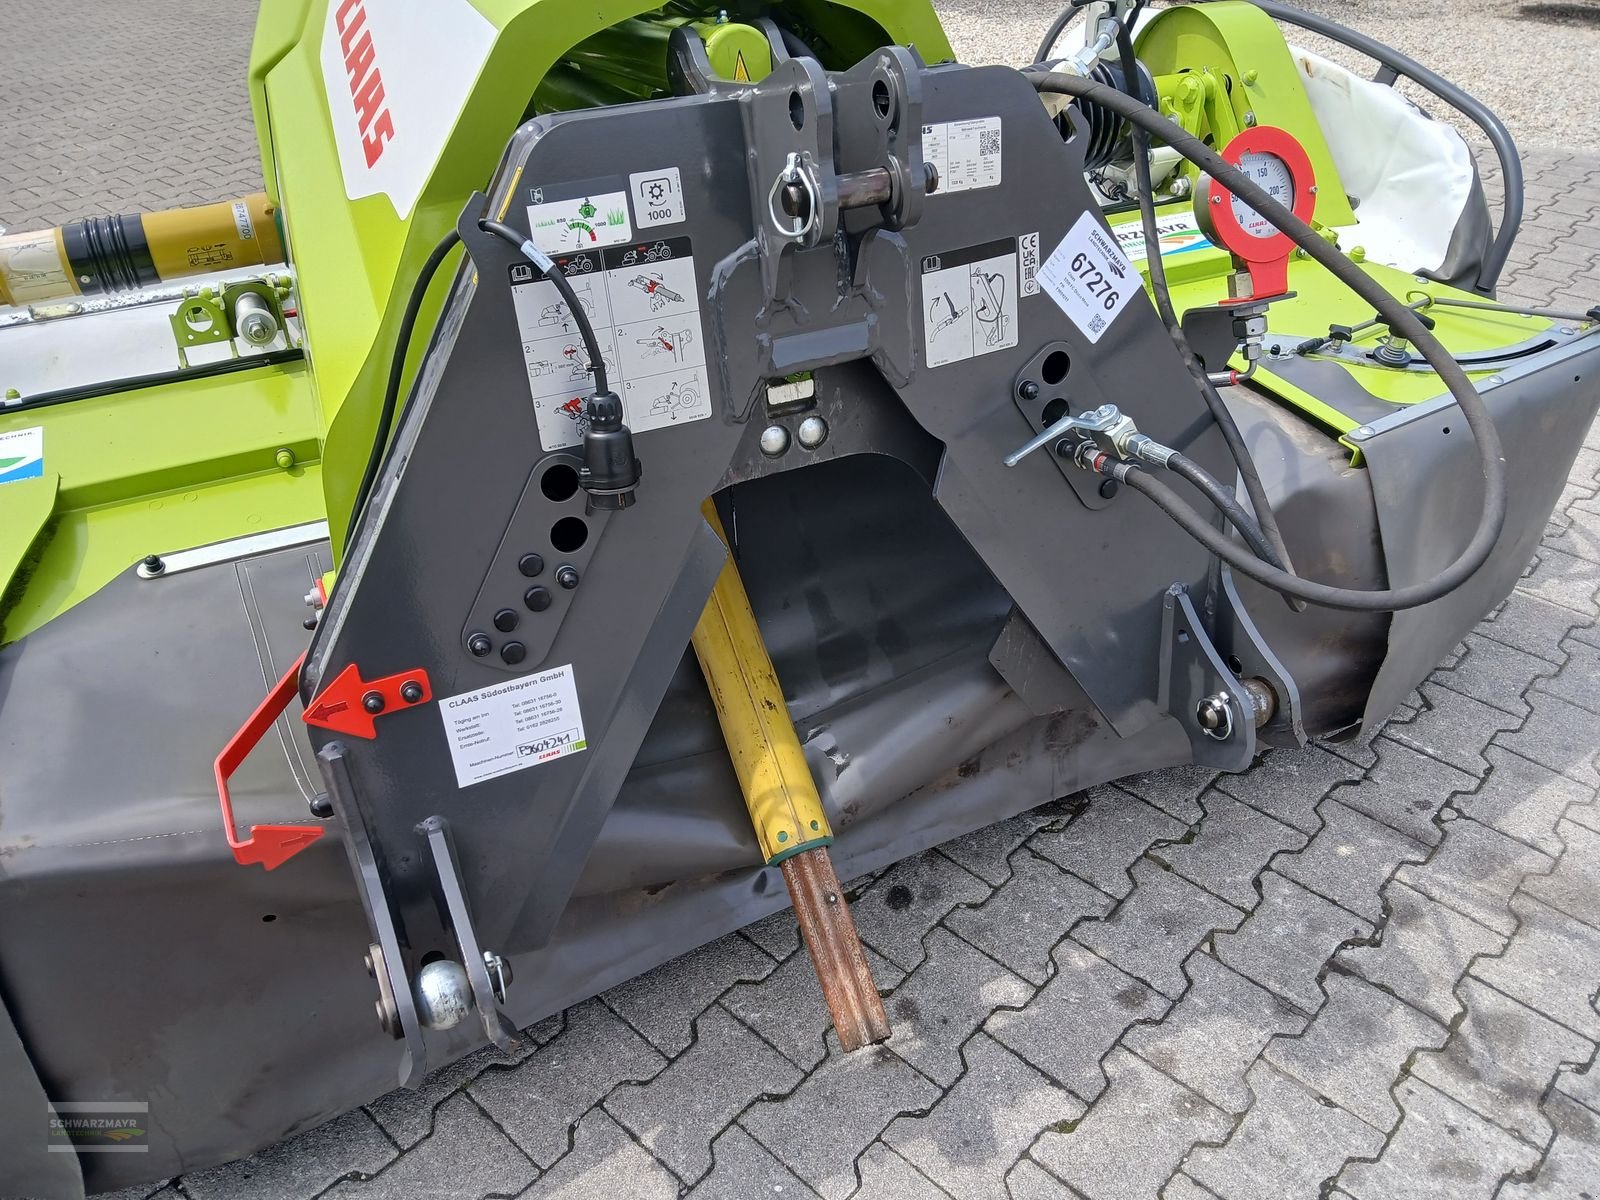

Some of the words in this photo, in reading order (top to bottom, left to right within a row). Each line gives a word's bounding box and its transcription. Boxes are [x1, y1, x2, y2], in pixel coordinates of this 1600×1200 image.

[336, 0, 395, 169] CLAAS
[1257, 167, 1268, 178] 150
[1269, 185, 1280, 196] 200
[647, 208, 672, 222] 1000
[1239, 214, 1244, 224] 0
[1090, 229, 1127, 272] SCHWARZMAYR
[1071, 252, 1120, 311] 67276
[618, 328, 628, 337] 2.
[626, 382, 636, 390] 3.
[535, 400, 545, 409] 3.
[448, 695, 479, 709] CLAAS
[480, 679, 538, 700] Südostbayern
[539, 670, 565, 683] GmbH
[538, 749, 561, 760] CLAAS
